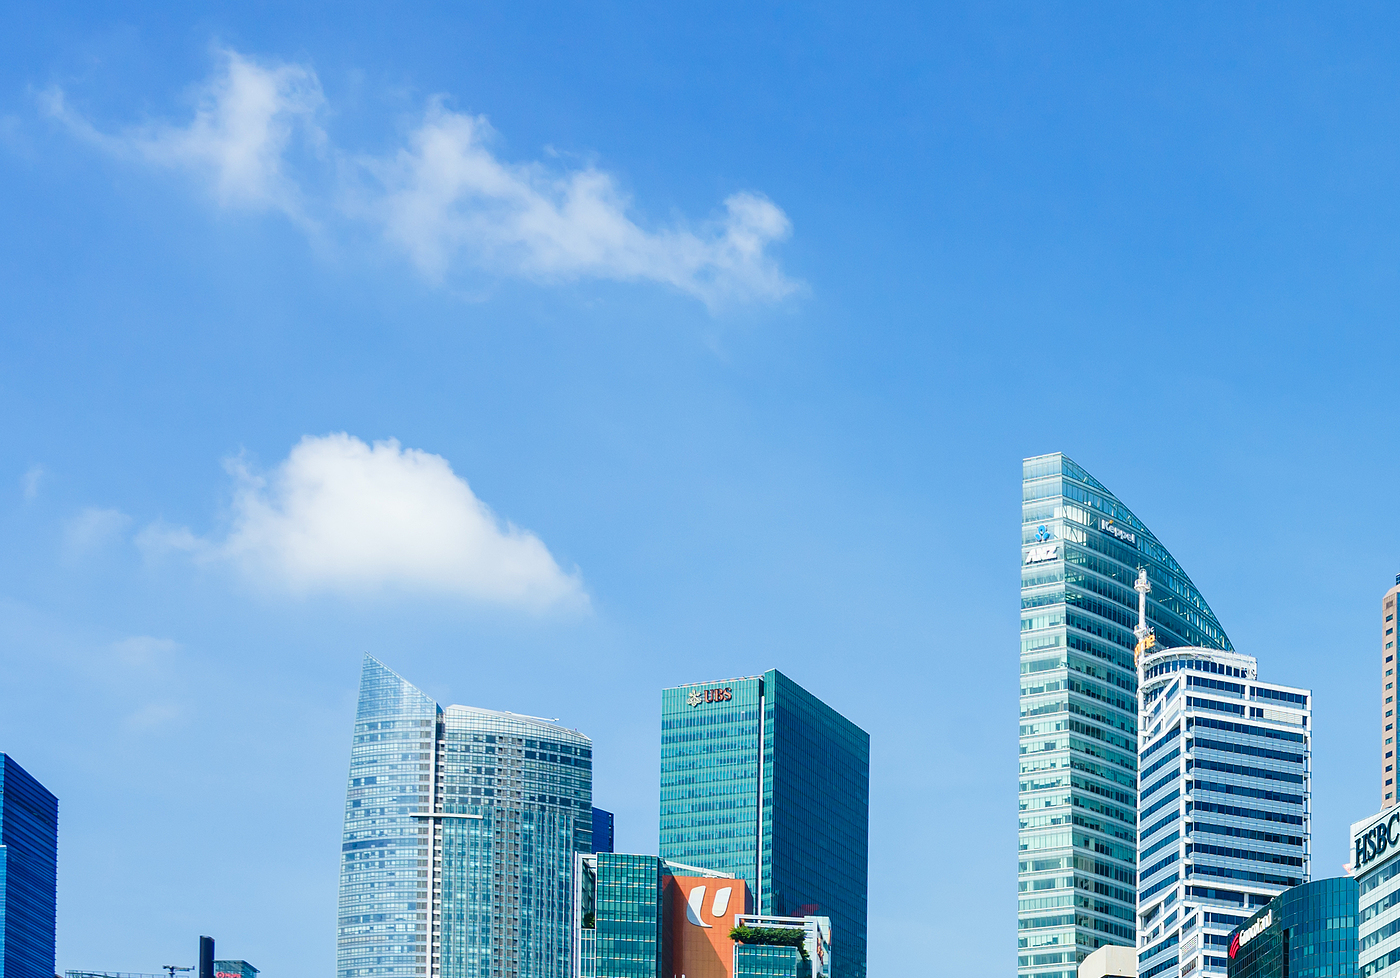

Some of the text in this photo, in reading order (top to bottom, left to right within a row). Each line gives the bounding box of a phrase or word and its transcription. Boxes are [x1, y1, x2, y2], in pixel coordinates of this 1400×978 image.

[1101, 519, 1136, 544] Keppel
[1026, 545, 1058, 564] ANZ
[704, 687, 732, 704] UBS
[1354, 812, 1400, 868] HSBC
